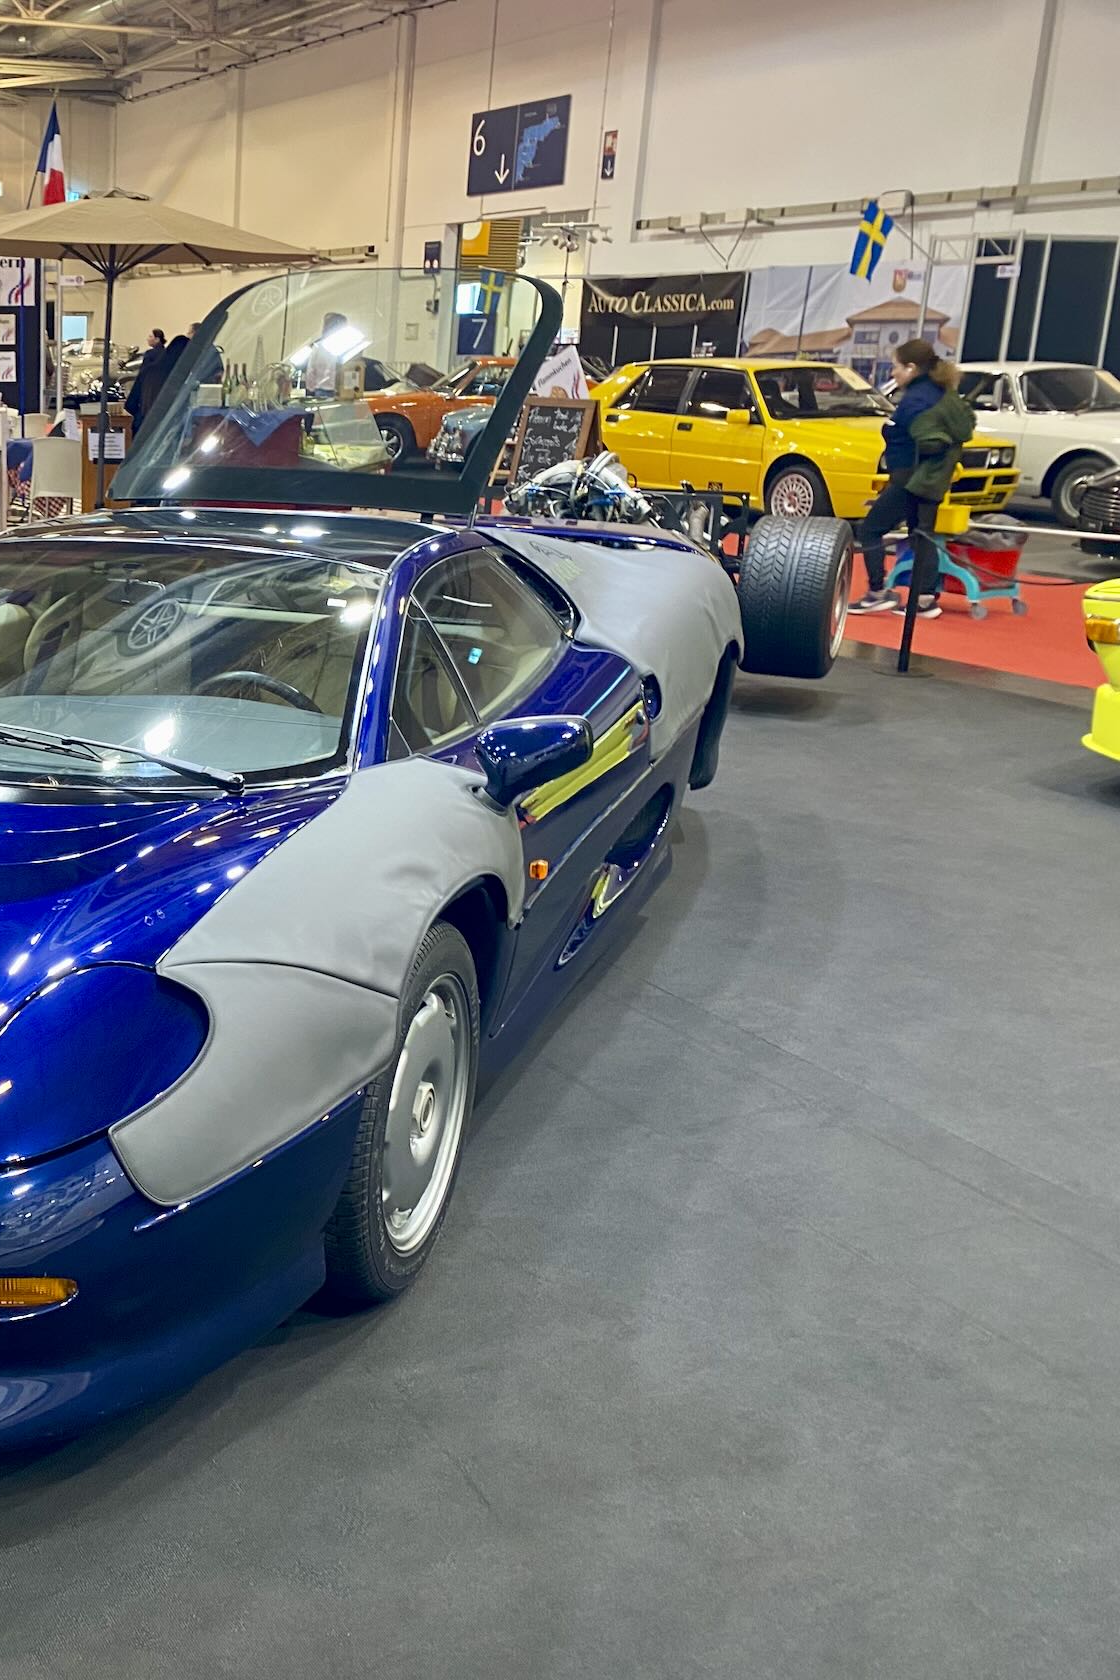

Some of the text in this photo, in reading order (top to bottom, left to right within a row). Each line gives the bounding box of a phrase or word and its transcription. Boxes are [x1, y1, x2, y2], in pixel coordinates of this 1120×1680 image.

[473, 119, 486, 156] 6
[588, 291, 735, 313] AUTO CLASSICA.com
[471, 318, 488, 349] 7
